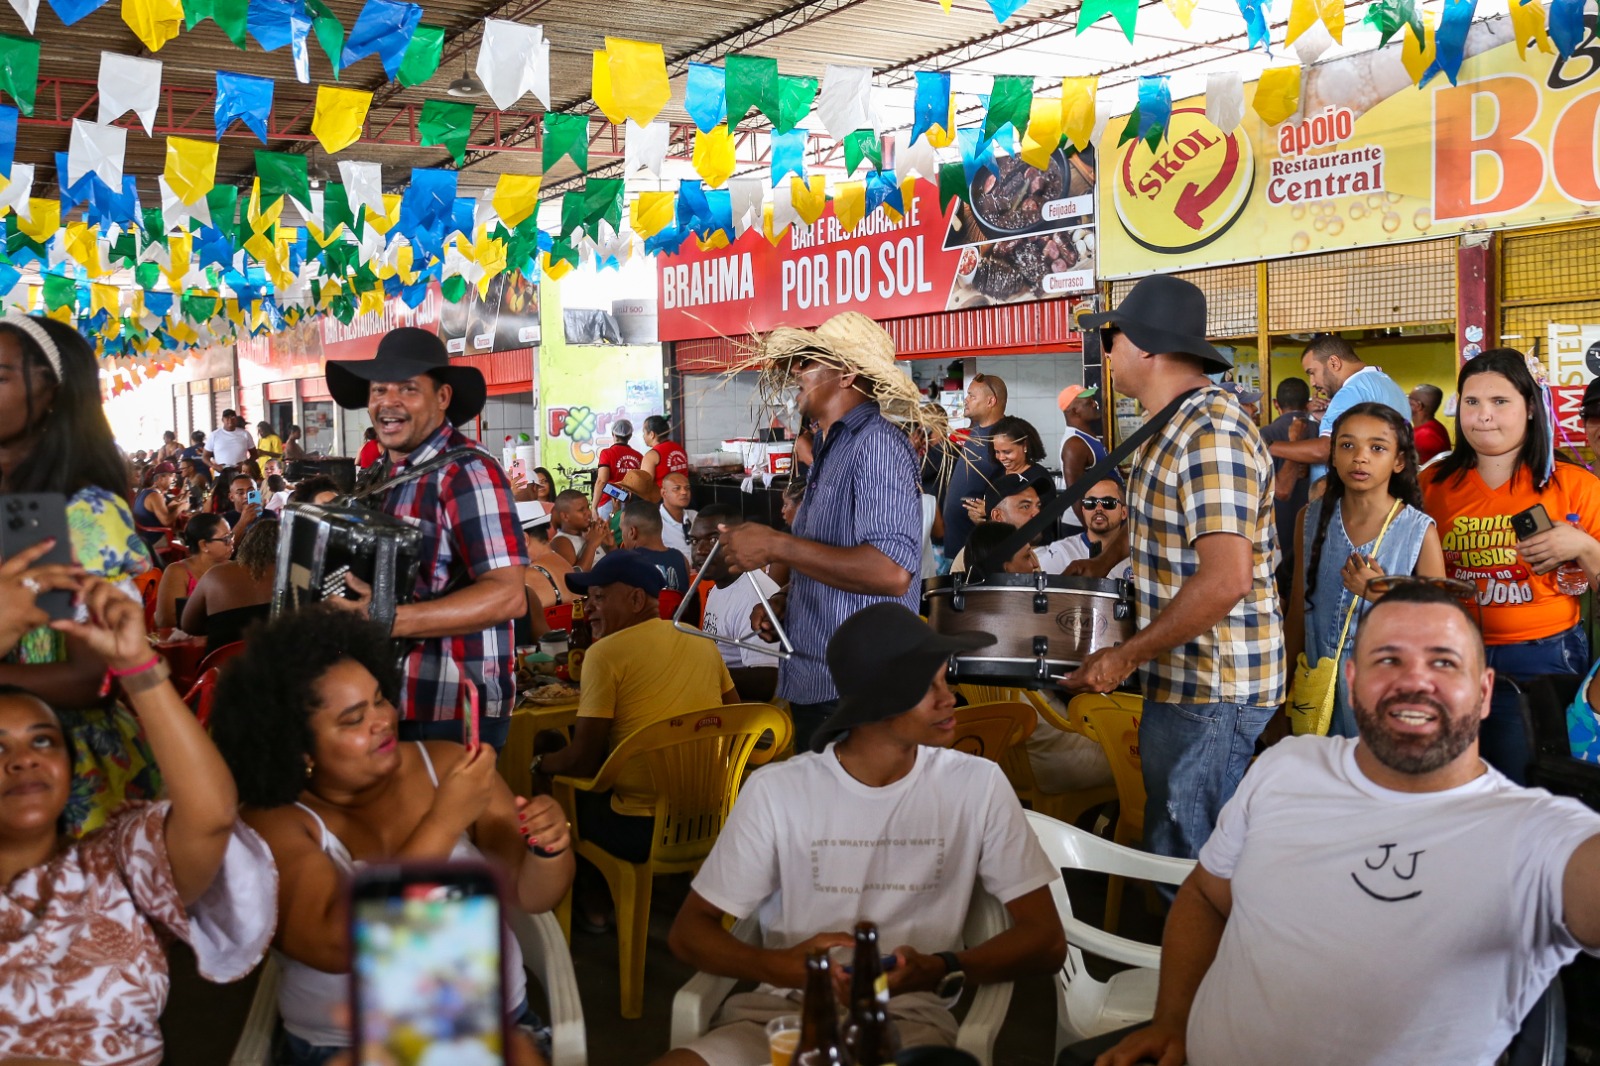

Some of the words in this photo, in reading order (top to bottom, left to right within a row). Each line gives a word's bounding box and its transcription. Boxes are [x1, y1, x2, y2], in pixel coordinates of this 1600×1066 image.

[1280, 108, 1352, 156] apoio
[1139, 129, 1221, 200] SKOL
[1272, 147, 1382, 177] Restaurante
[1268, 162, 1382, 204] Central
[1048, 201, 1077, 218] Feijoada
[791, 223, 815, 250] BAR
[817, 218, 825, 246] E
[663, 252, 755, 310] BRAHMA
[782, 254, 829, 312] POR
[836, 245, 871, 304] DO
[878, 235, 932, 299] SOL
[1049, 276, 1084, 290] Churrasco
[1453, 548, 1517, 568] Jesus
[1496, 569, 1512, 580] DO
